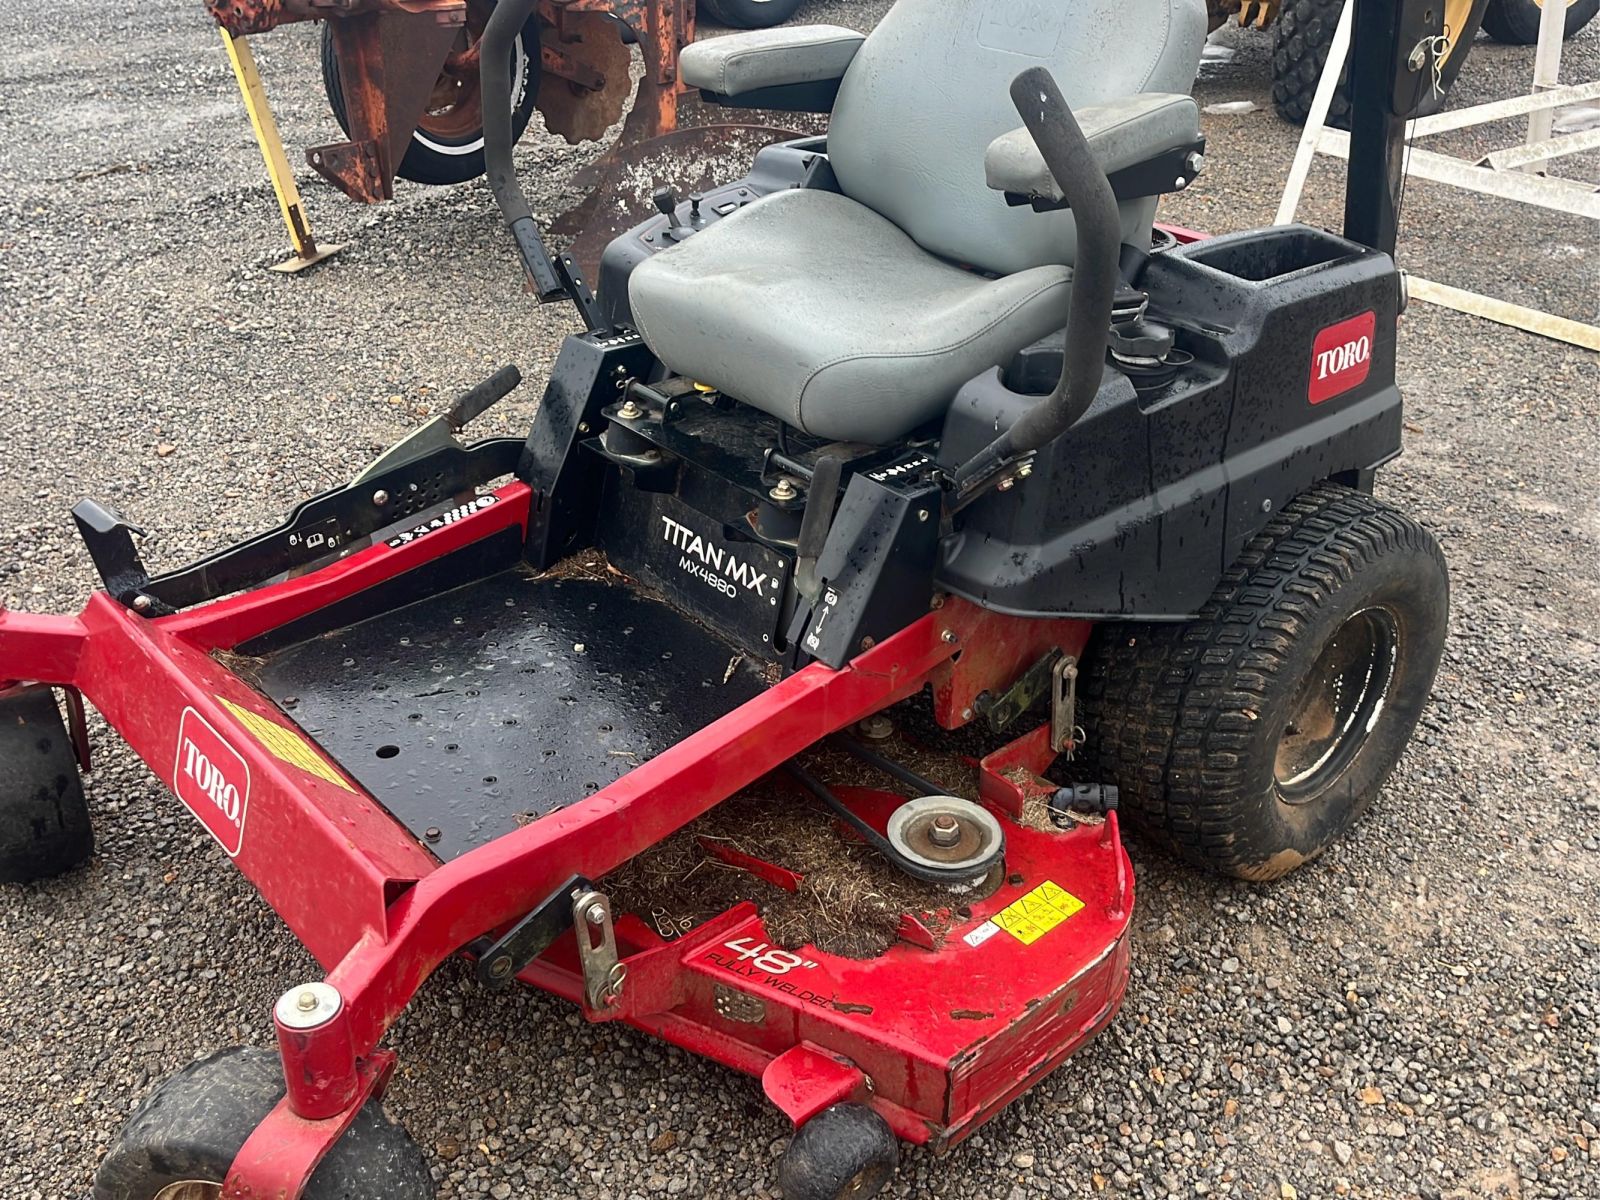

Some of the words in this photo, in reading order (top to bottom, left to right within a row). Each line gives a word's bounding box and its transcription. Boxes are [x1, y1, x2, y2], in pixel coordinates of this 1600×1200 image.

[1316, 335, 1369, 380] TORO
[662, 515, 725, 571] TITAN
[724, 555, 767, 596] MX
[678, 556, 737, 598] MX4880
[184, 737, 240, 821] TORO
[704, 952, 762, 977] FULLY
[724, 937, 819, 974] 48"
